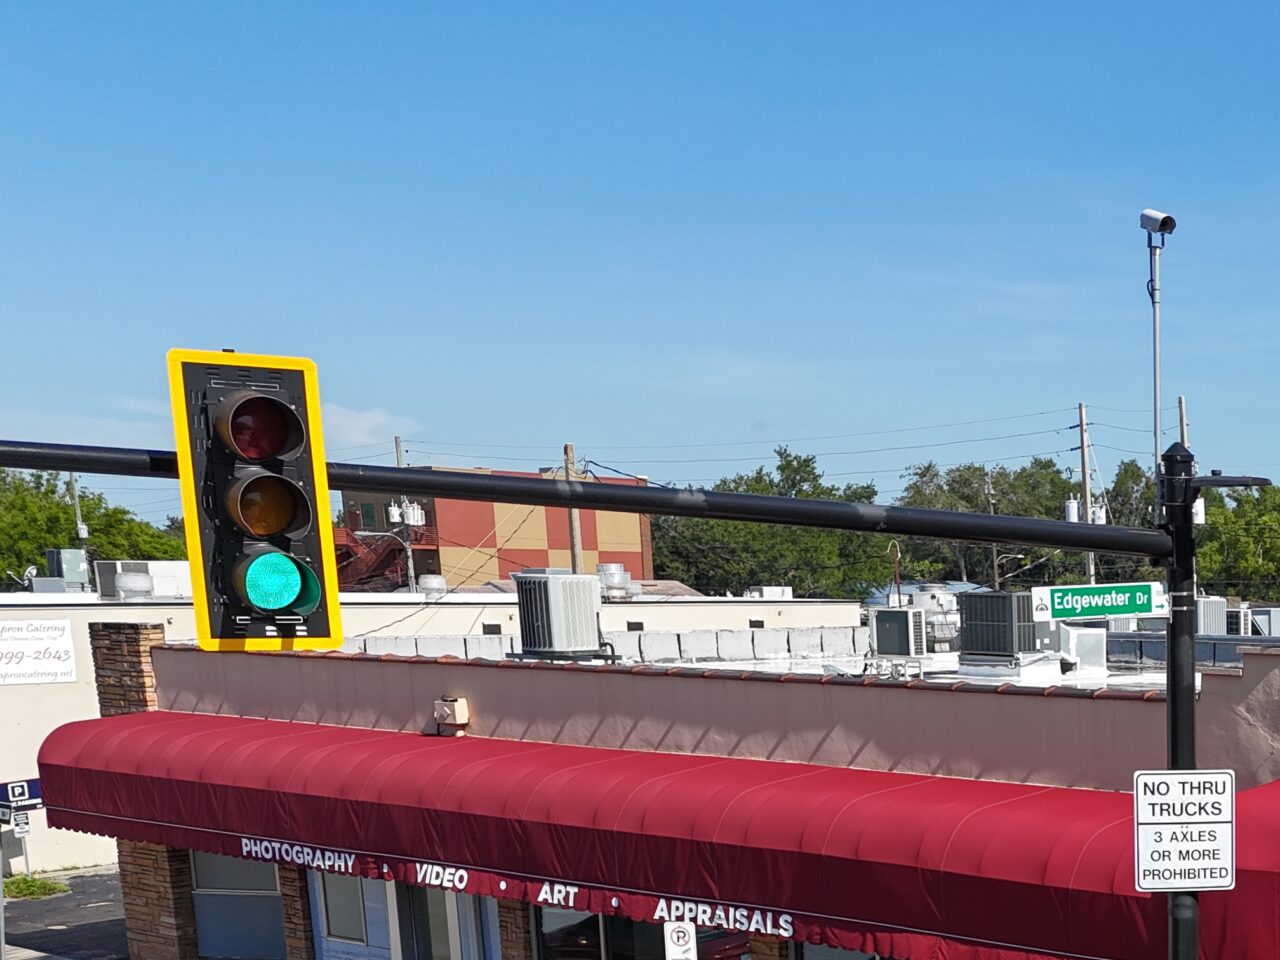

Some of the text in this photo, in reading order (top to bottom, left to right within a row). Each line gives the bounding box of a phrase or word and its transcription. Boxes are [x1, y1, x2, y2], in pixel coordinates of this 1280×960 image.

[1054, 590, 1148, 613] Edgewater Dr
[0, 623, 65, 638] pron Catering
[1143, 780, 1226, 796] NO THRU
[1148, 801, 1222, 817] TRUCKS
[1154, 830, 1217, 843] 3 AXLES
[1150, 848, 1221, 862] OR MORE
[1143, 867, 1229, 880] PROHIBITED
[241, 838, 793, 937] PHOTOGRAPHY VIDEO ART APPRAISALS
